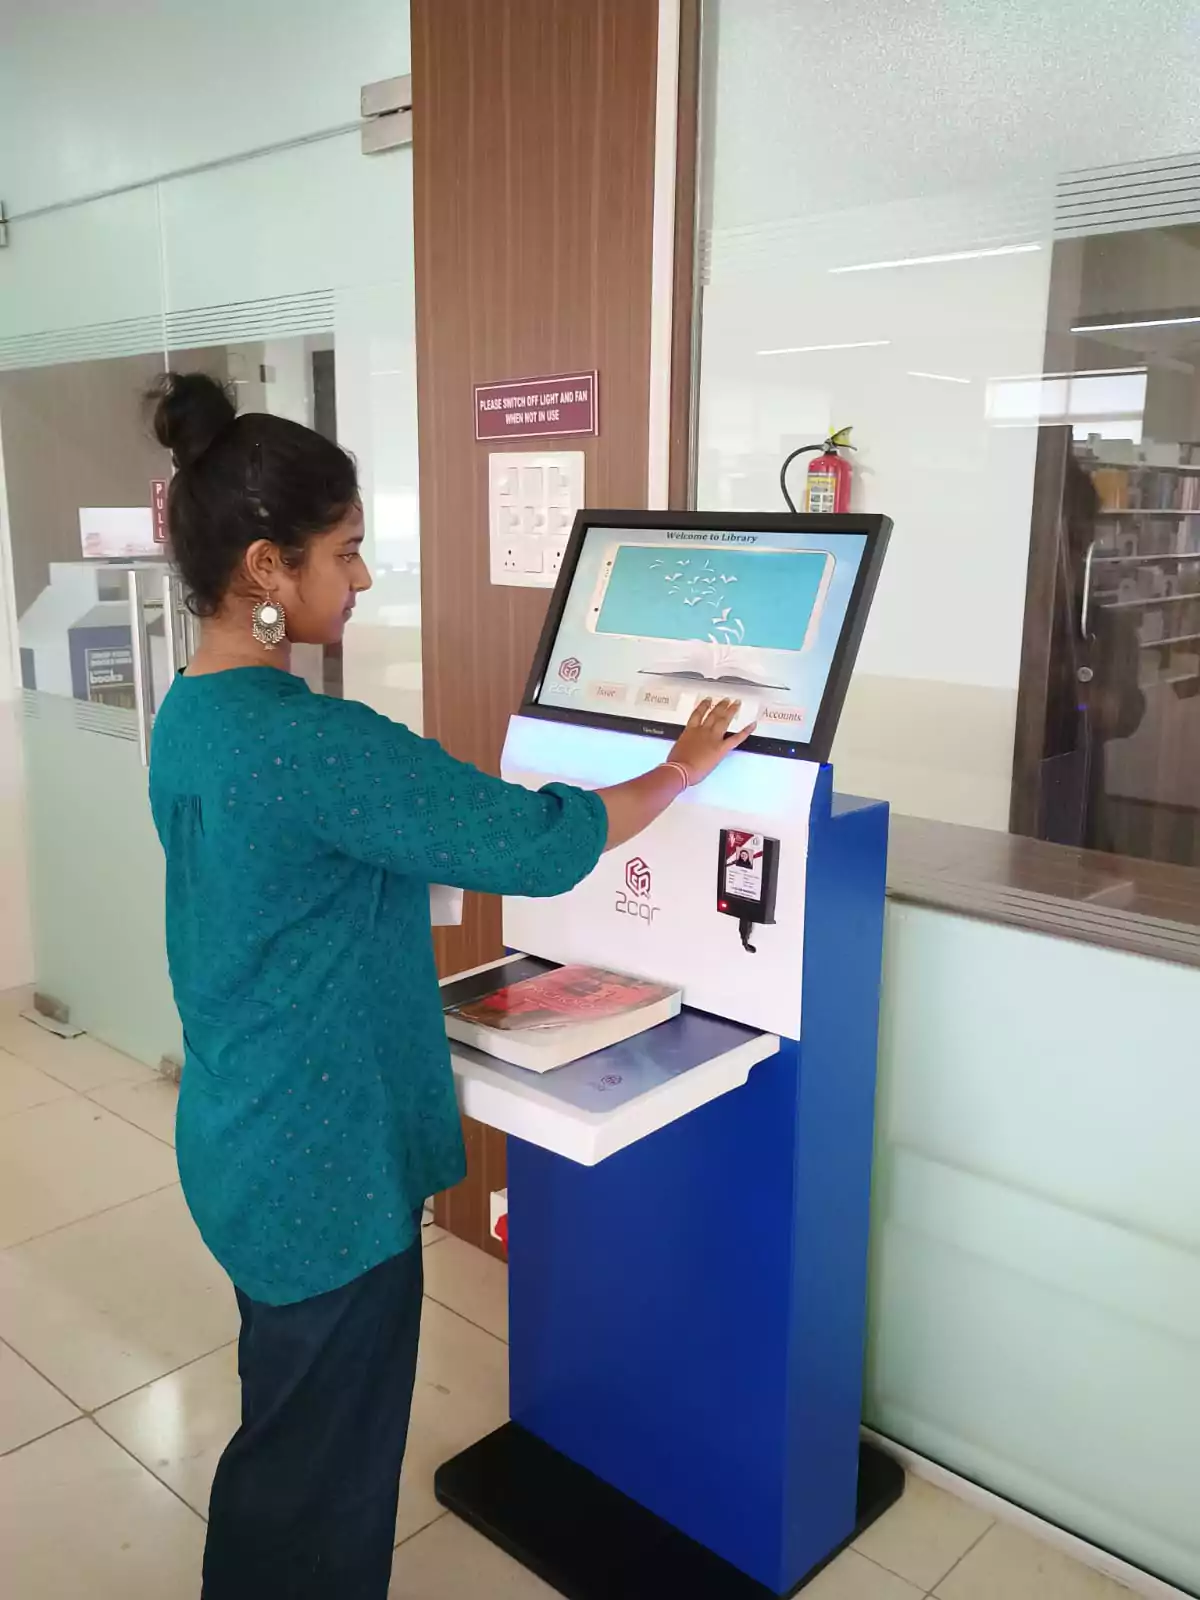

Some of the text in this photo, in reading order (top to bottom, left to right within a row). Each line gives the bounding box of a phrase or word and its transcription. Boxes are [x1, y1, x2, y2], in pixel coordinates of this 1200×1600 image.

[480, 390, 588, 411] PLEASE SWITCH OFF LIGHT AND FAN
[505, 409, 560, 425] WHEN NOT IN USE
[155, 483, 165, 539] PULL
[666, 531, 758, 544] Welcome to Library
[596, 686, 616, 697] Issue
[644, 692, 670, 705] Return
[762, 707, 803, 722] Accounts
[615, 890, 661, 926] 2cqr
